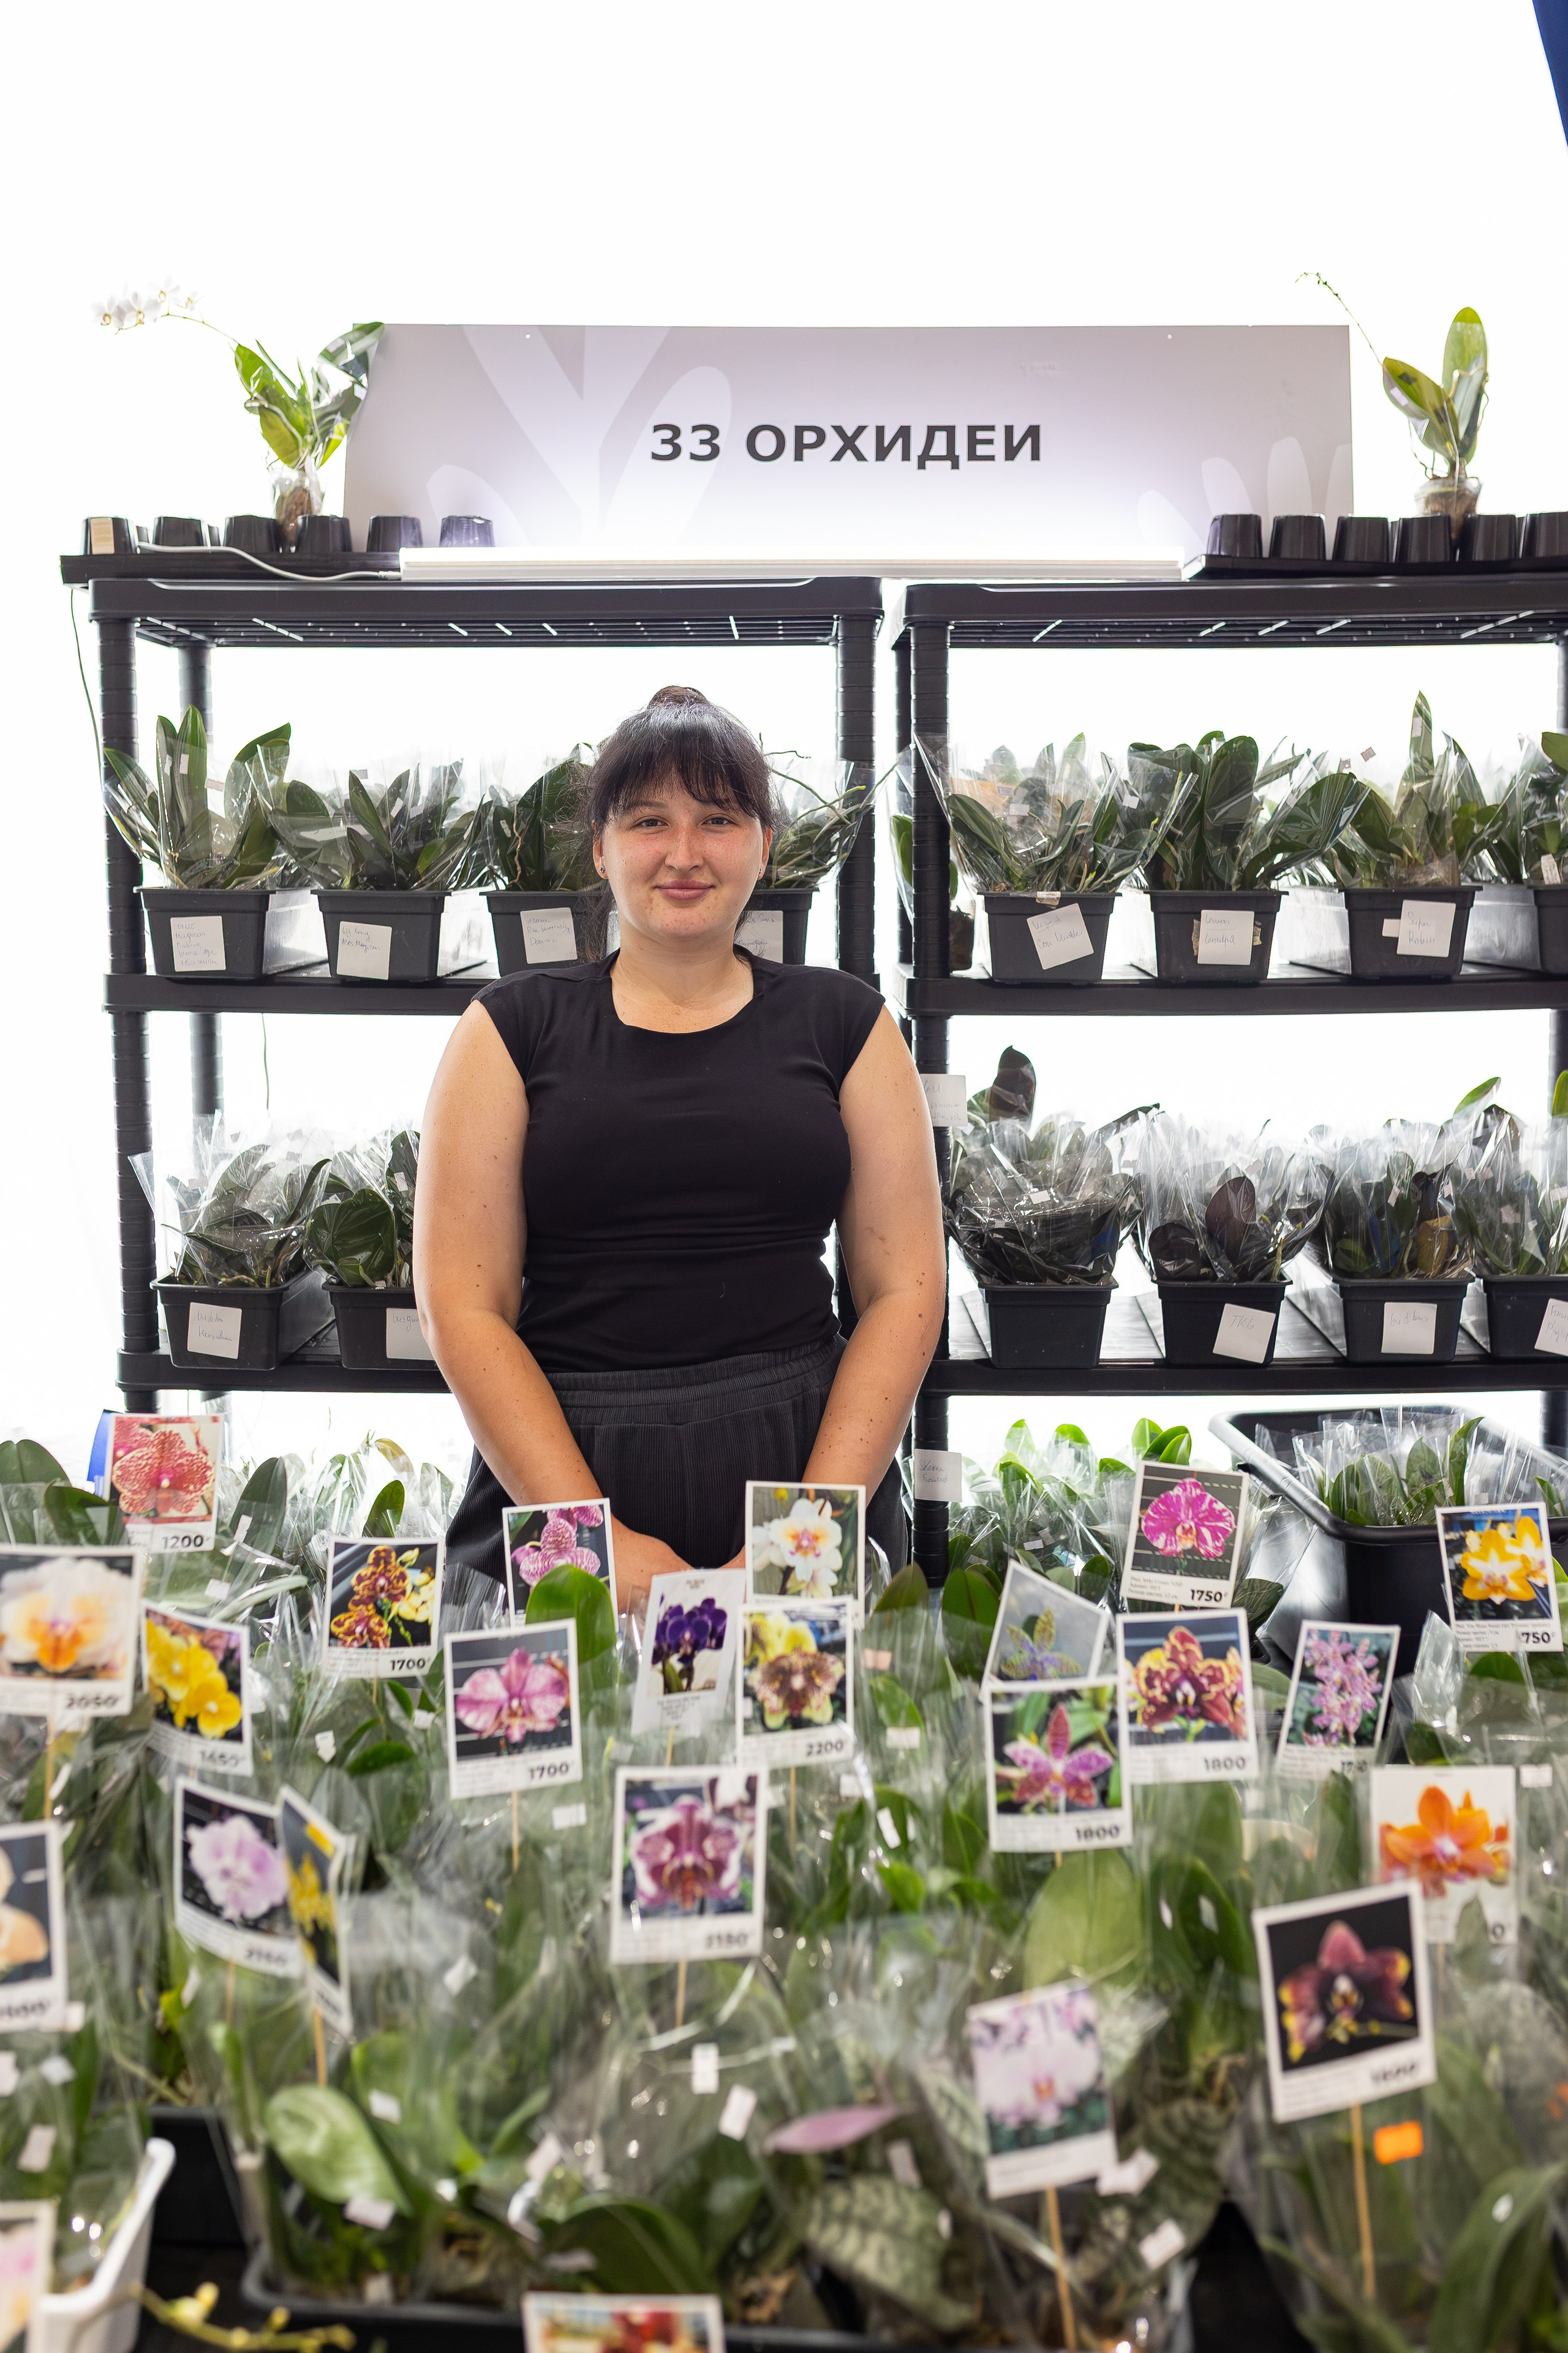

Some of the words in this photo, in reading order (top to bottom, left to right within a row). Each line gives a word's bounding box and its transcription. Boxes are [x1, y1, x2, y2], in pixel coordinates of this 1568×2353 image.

[650, 423, 720, 463] 33
[745, 424, 1042, 470] ОРХИДЕИ
[162, 1535, 204, 1549] 1200
[1190, 1588, 1223, 1603] 1750
[391, 1658, 426, 1671] 1700
[806, 1740, 844, 1757] 2200
[529, 1761, 570, 1780] 1700
[1204, 1756, 1247, 1772] 1800
